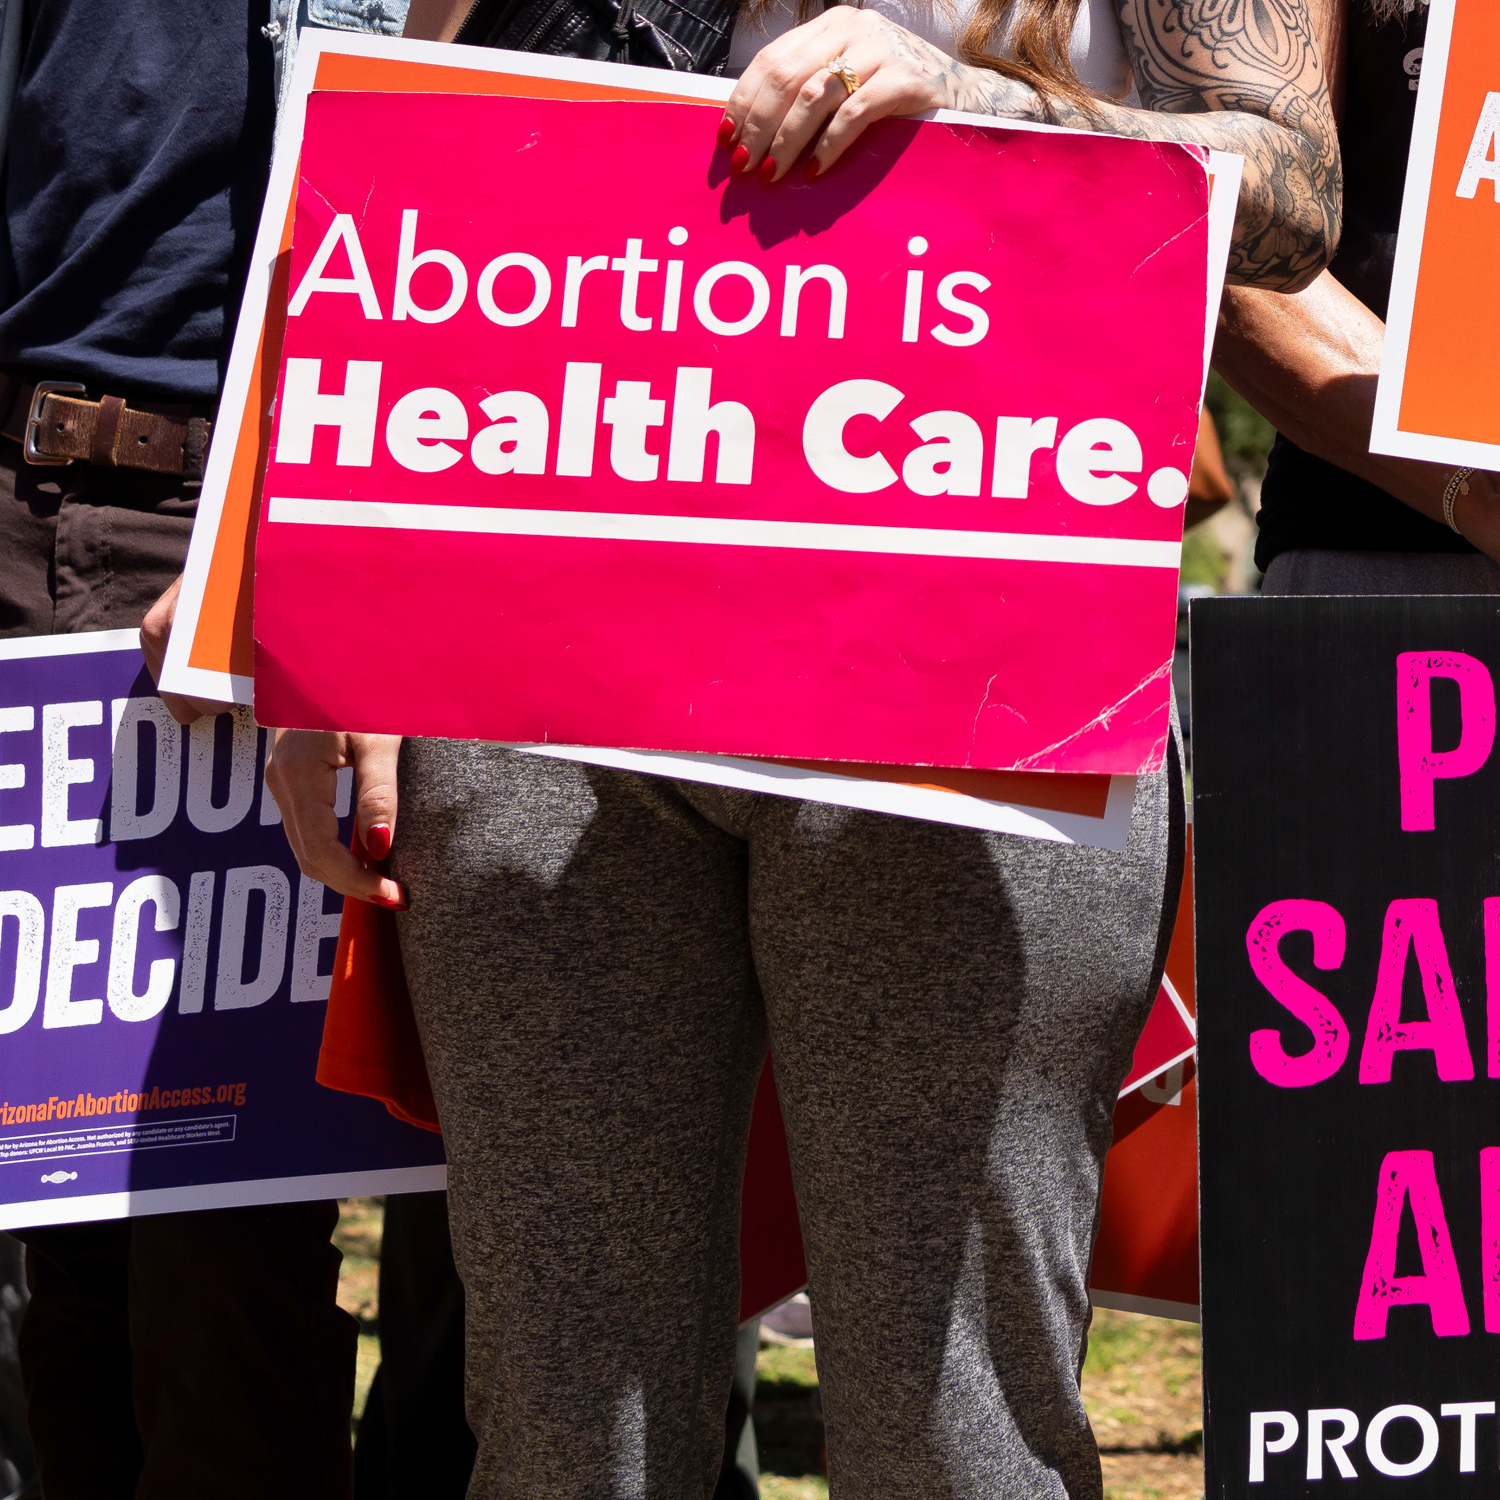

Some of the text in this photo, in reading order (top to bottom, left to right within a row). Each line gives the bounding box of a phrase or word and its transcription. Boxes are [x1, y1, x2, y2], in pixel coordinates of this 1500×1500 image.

[286, 208, 993, 347] Abortion is
[273, 356, 1188, 510] Health Care.
